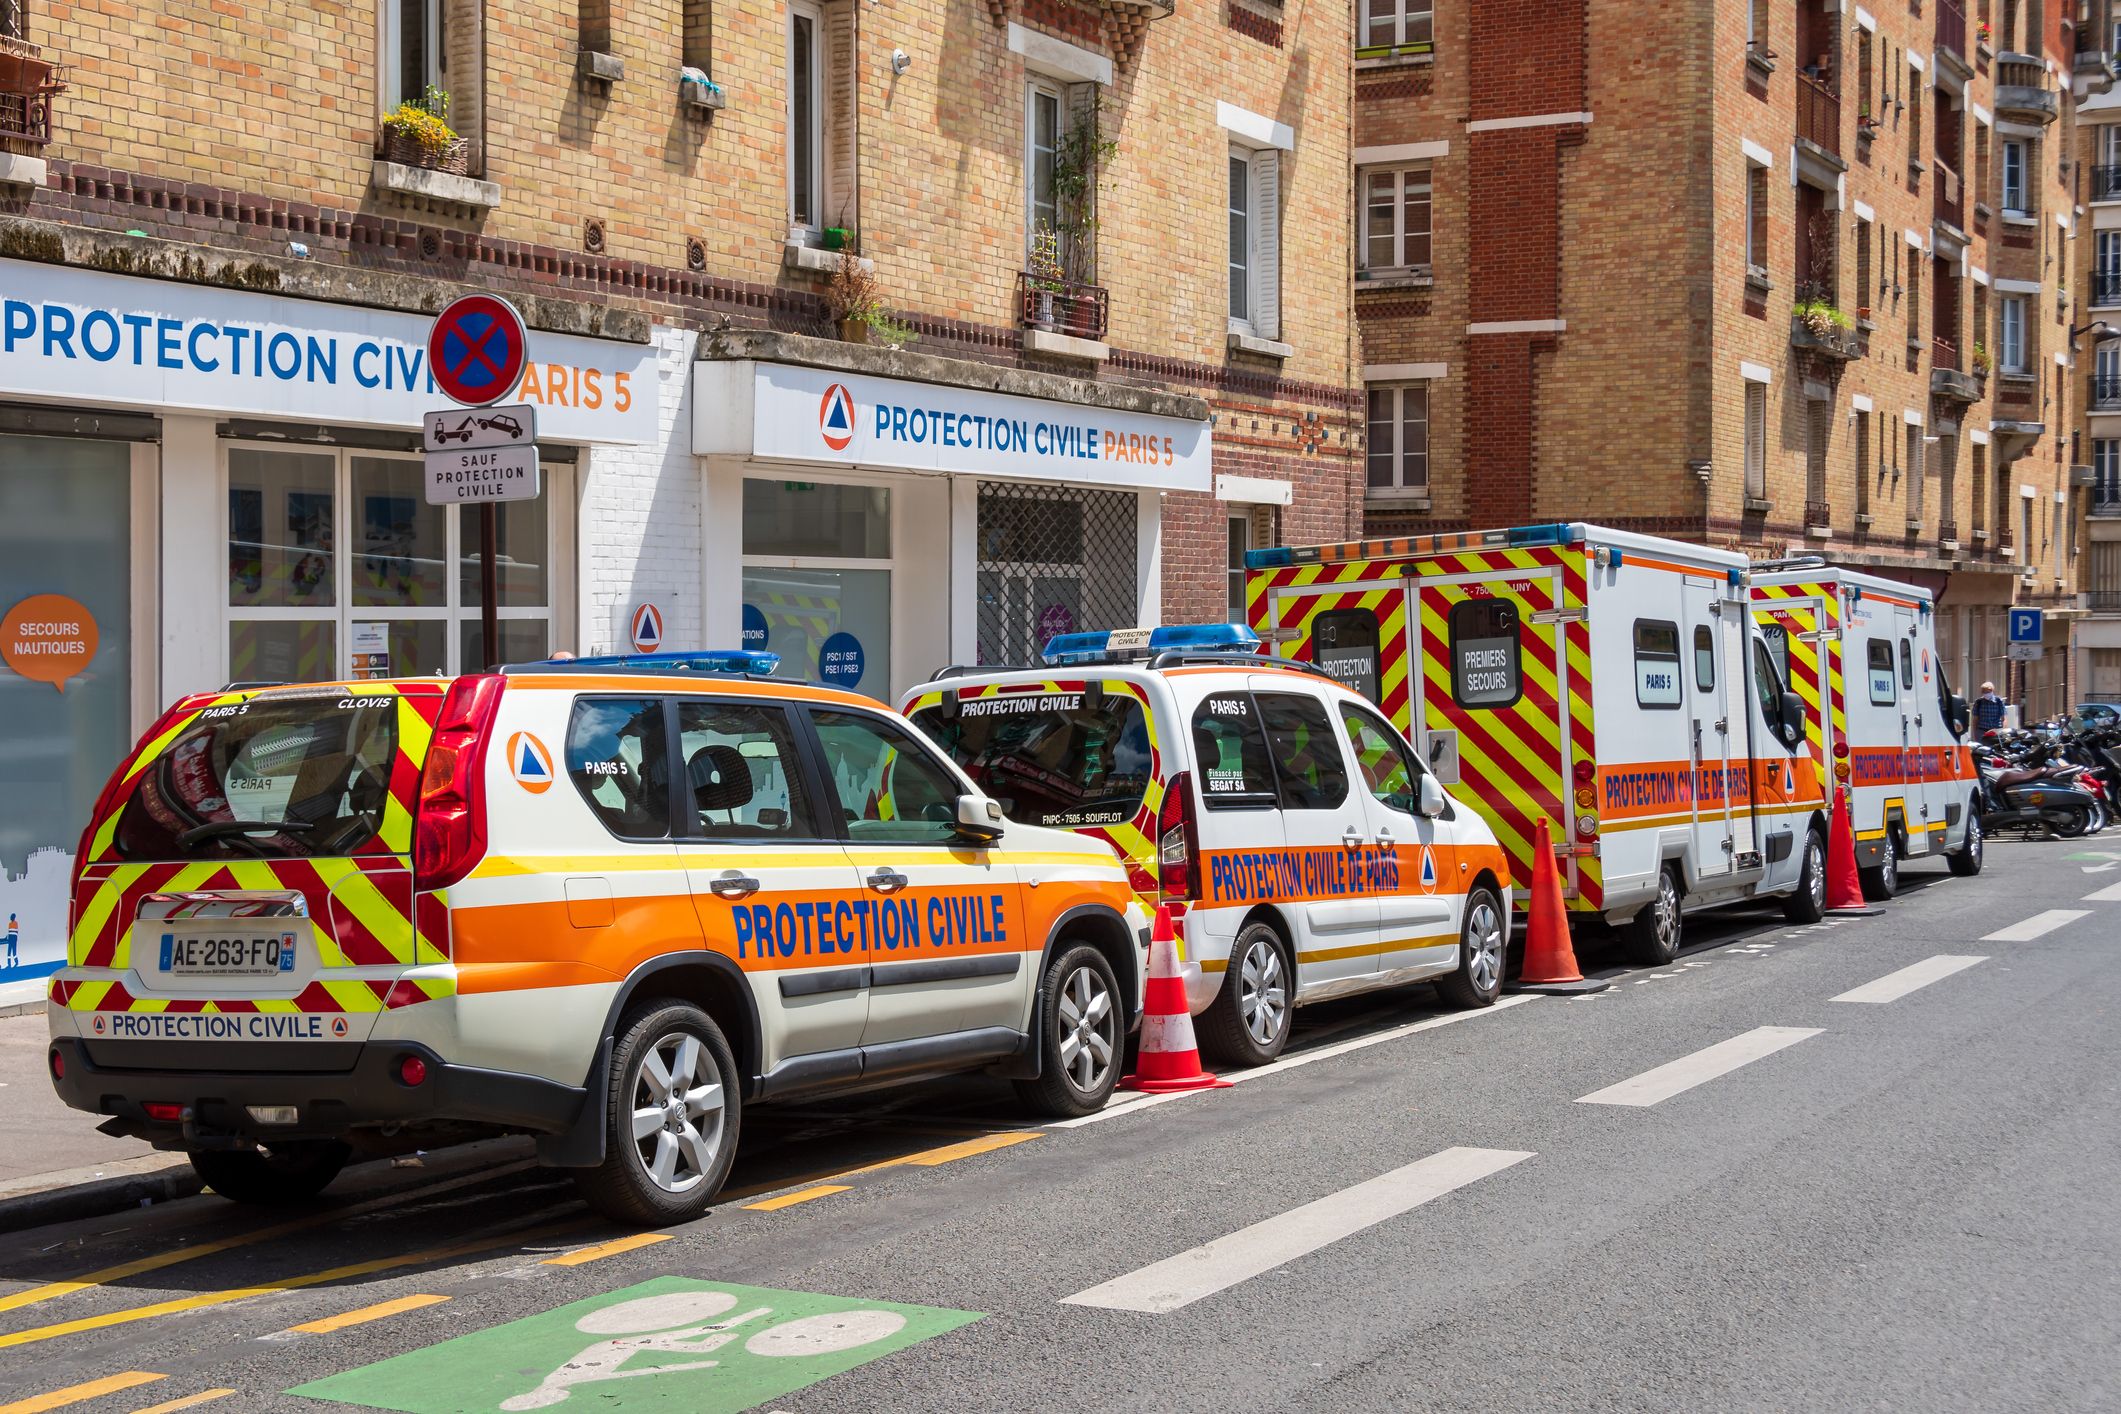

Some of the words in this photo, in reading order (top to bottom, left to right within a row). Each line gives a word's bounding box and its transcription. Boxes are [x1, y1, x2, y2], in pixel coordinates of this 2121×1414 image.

[4, 299, 337, 385] PROTECTION
[352, 341, 444, 395] CIVI
[517, 361, 603, 411] ARIS
[614, 371, 632, 413] 5
[875, 404, 1027, 453] PROTECTION
[1034, 422, 1098, 459] CIVILE
[1104, 430, 1159, 466] PARIS
[1163, 437, 1174, 466] 5
[461, 453, 497, 467] SAUF
[436, 466, 524, 484] PROTECTION
[457, 483, 504, 497] CIVILE
[19, 622, 80, 636] SECOURS
[2018, 615, 2033, 636] P
[1110, 630, 1152, 639] PROTECTION
[1117, 637, 1139, 645] CIVILE
[14, 640, 85, 655] NAUTIQUES
[826, 652, 841, 662] PSC1
[845, 651, 858, 661] SST
[1464, 648, 1507, 669] PREMIERS
[825, 664, 840, 674] PSE1
[844, 664, 859, 674] PSE2
[1322, 657, 1372, 676] PROTECTION
[1467, 670, 1507, 692] SECOURS
[1646, 673, 1666, 690] PARIS
[1666, 674, 1671, 690] 5
[201, 705, 238, 719] PARIS
[239, 704, 250, 715] 5
[337, 697, 392, 710] CLOVIS
[961, 698, 1038, 718] PROTECTION
[1039, 695, 1081, 712] CIVILE
[1209, 699, 1240, 715] PARIS
[1240, 700, 1247, 715] 5
[584, 761, 618, 775] PARIS
[619, 762, 628, 775] 5
[1209, 779, 1234, 791] SEGAT
[1234, 779, 1246, 791] SA
[1605, 771, 1675, 809] PROTECTION
[1711, 769, 1725, 799] DE
[1042, 814, 1061, 825] FNPC
[1065, 813, 1081, 824] 7505
[1085, 812, 1122, 823] SOUFFLOT
[1211, 852, 1303, 902] PROTECTION
[1304, 850, 1346, 897] CIVILE
[1347, 851, 1364, 893] DE
[1365, 849, 1399, 892] PARIS
[731, 897, 921, 959] PROTECTION
[927, 894, 1007, 948] CIVILE
[173, 938, 280, 967] AE-263-FQ
[281, 953, 293, 968] 75
[112, 1014, 242, 1038] PROTECTION
[249, 1015, 323, 1038] CIVILE
